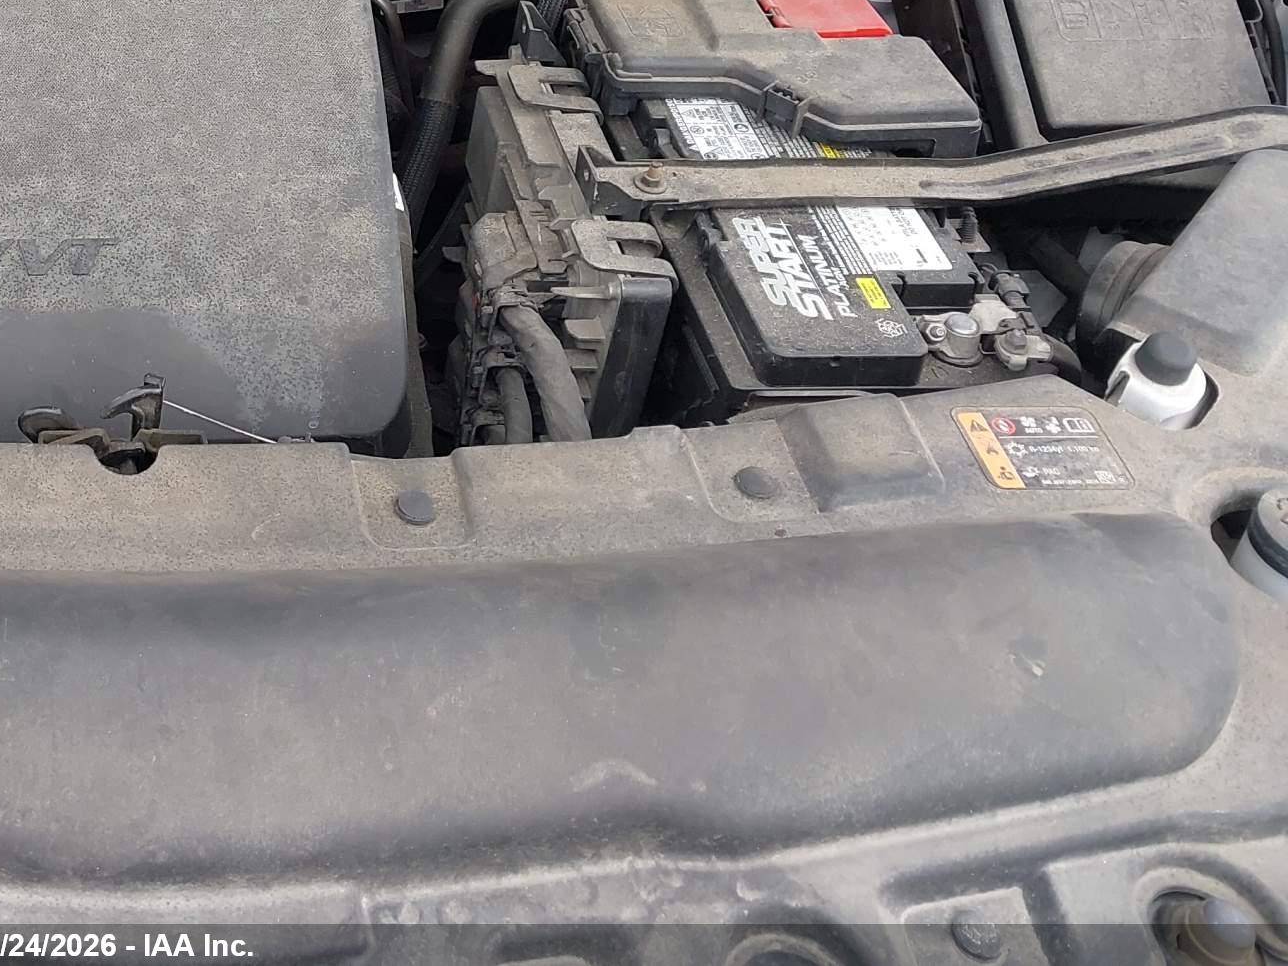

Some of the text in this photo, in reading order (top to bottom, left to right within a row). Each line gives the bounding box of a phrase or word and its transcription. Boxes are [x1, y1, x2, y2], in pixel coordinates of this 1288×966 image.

[732, 217, 788, 306] SUPER
[753, 216, 833, 320] START
[797, 234, 858, 317] PLATINUM
